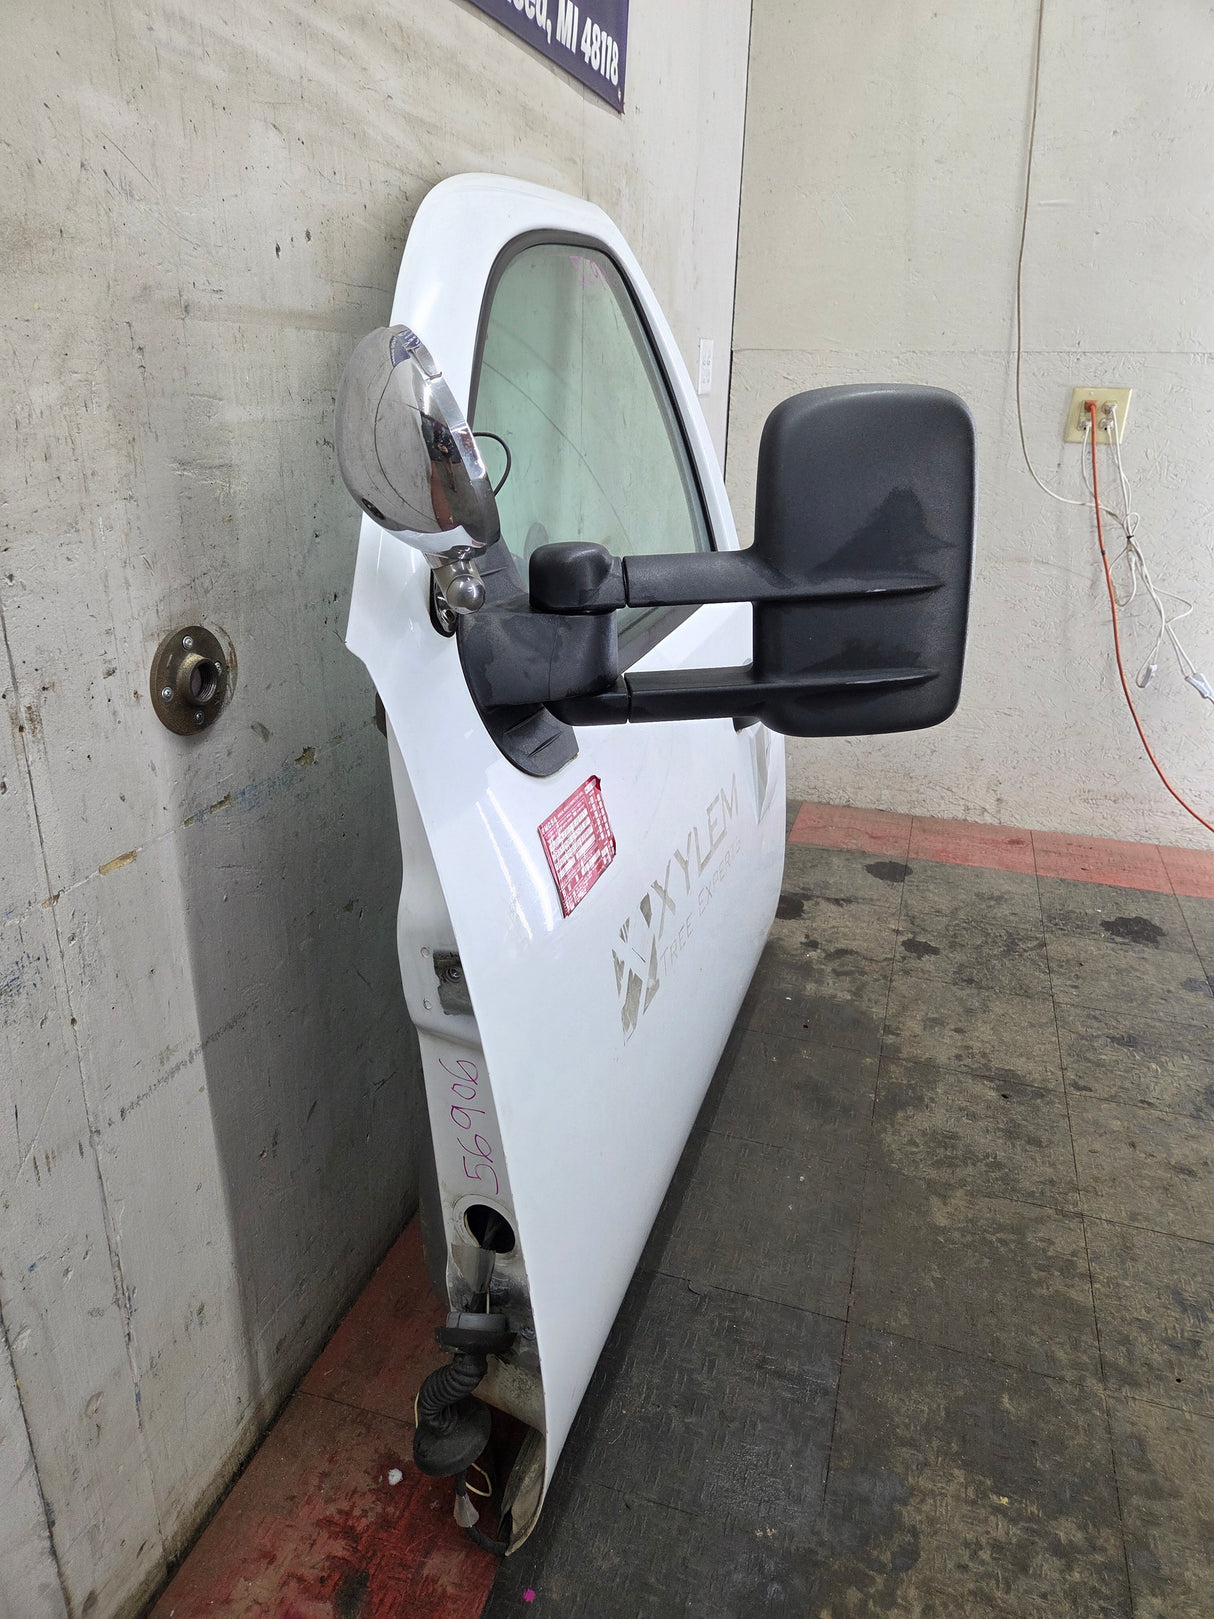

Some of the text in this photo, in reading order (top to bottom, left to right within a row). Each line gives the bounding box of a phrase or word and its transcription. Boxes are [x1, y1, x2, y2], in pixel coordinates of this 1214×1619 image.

[556, 0, 579, 55] MI
[580, 17, 619, 86] 48118
[651, 772, 738, 941] XYLEM
[660, 912, 693, 976] TREE
[438, 1058, 499, 1195] 56906
